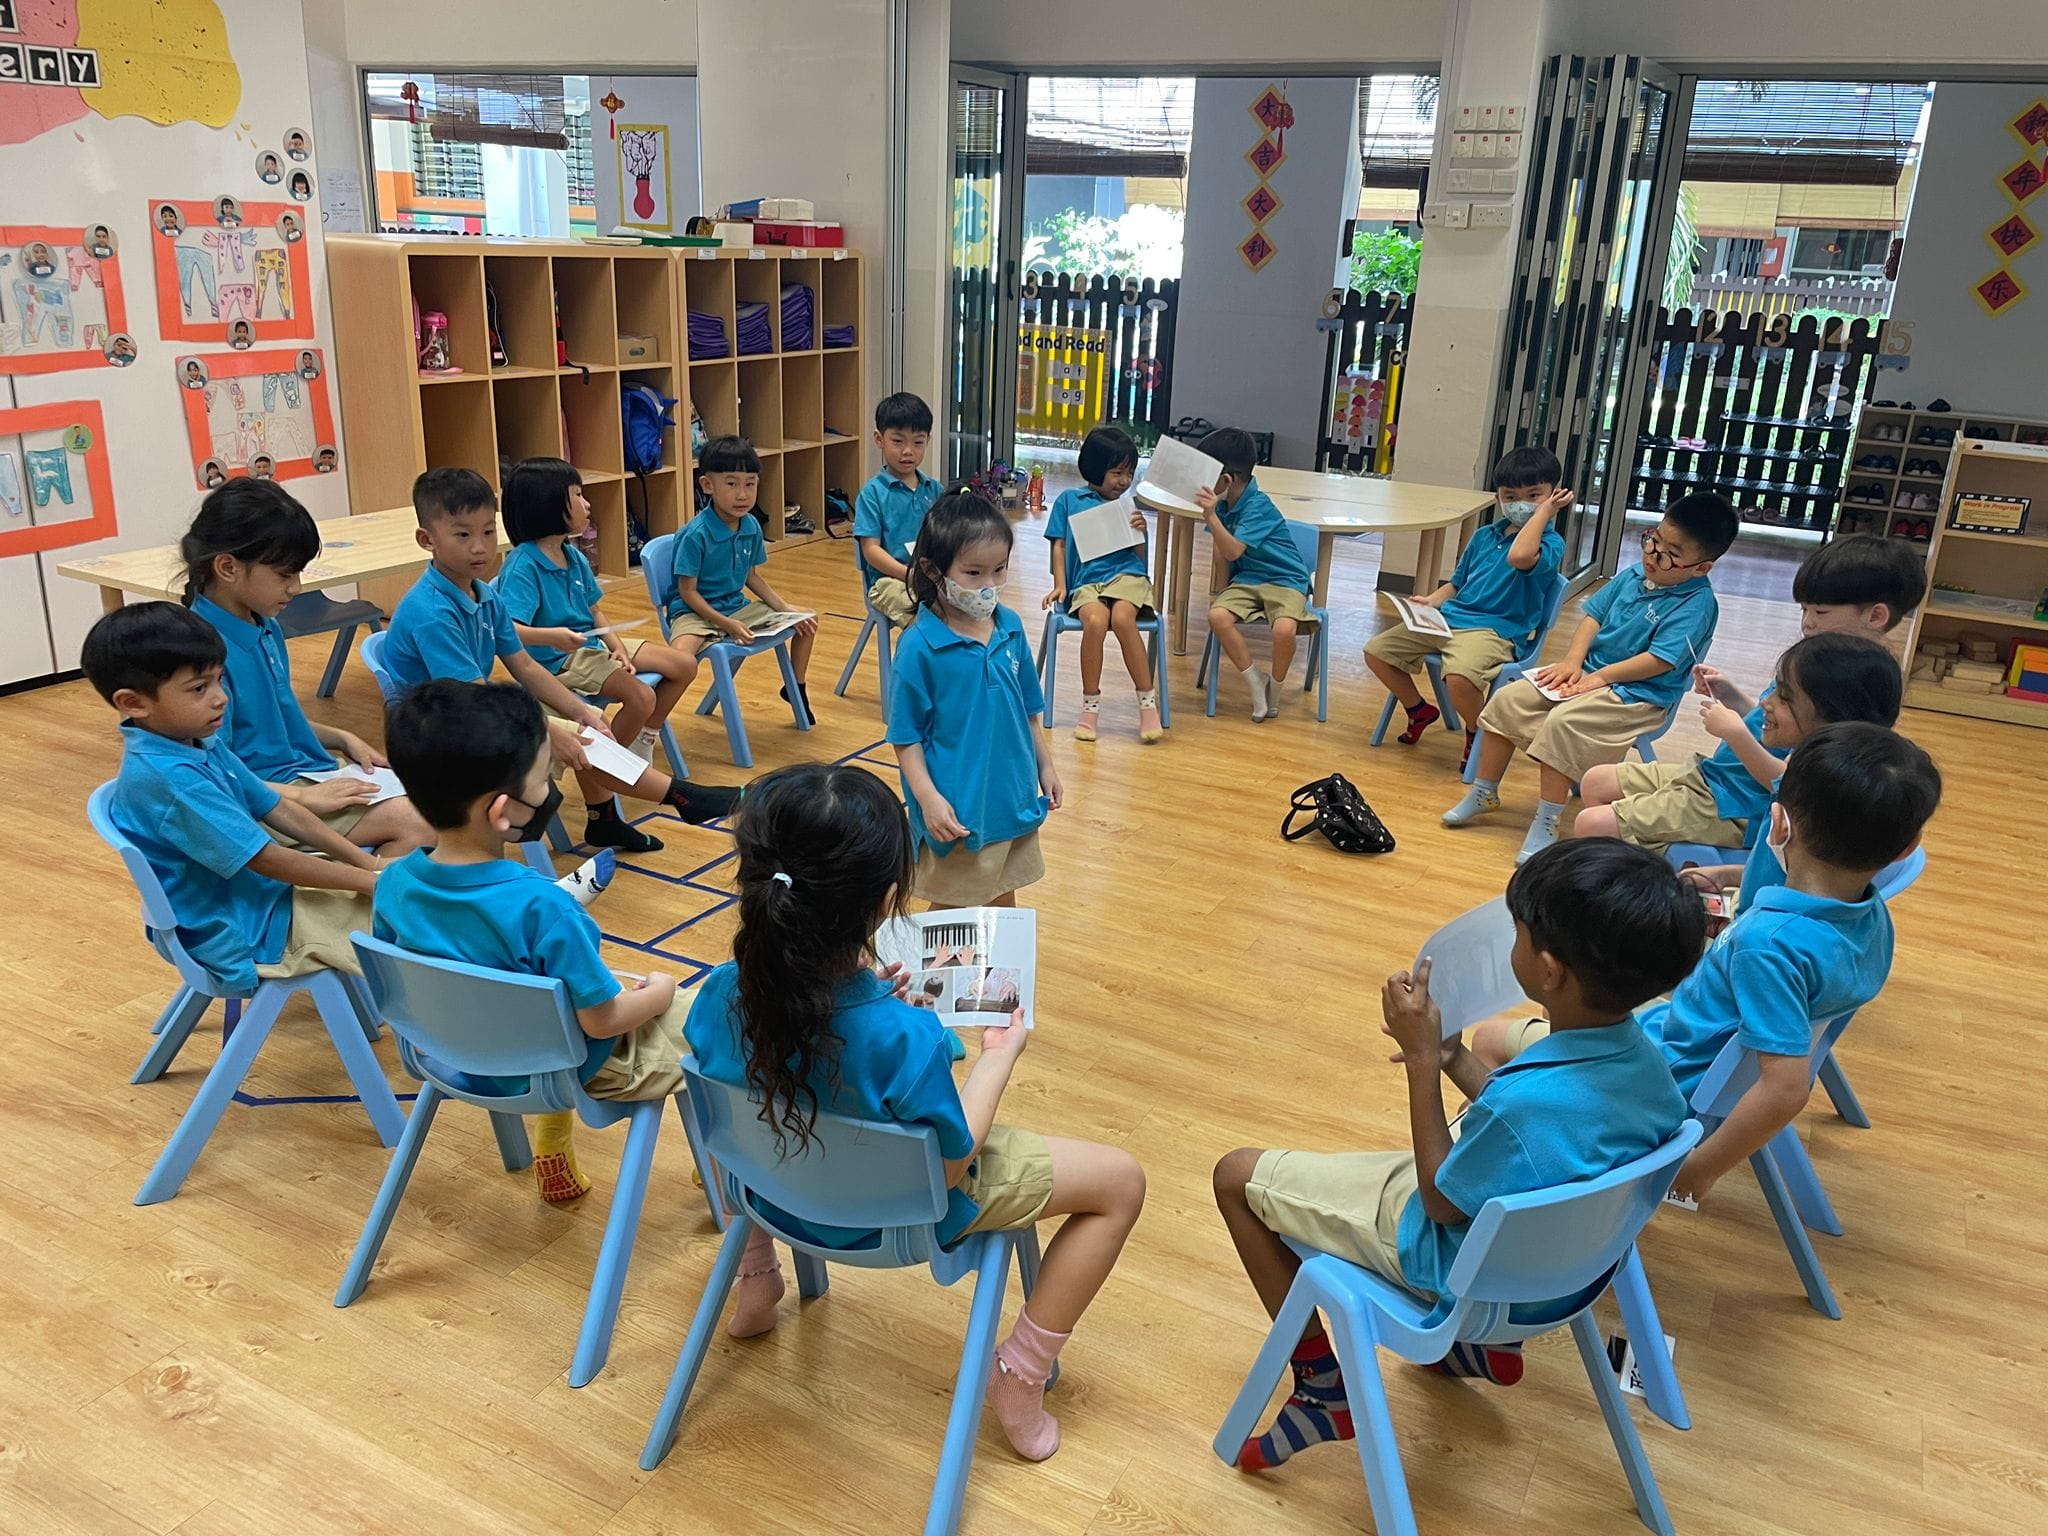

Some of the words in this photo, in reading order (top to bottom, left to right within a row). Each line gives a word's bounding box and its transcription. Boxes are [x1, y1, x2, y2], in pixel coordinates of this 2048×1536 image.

[1023, 271, 1039, 300] 3
[1122, 275, 1139, 306] 5
[1322, 288, 1344, 320] 6
[1386, 291, 1401, 324] 7
[1695, 309, 1724, 344] 12
[1755, 313, 1790, 348] 13
[1818, 316, 1853, 353] 14
[1879, 319, 1916, 355] 15
[1035, 334, 1062, 350] and
[1065, 335, 1105, 354] Read
